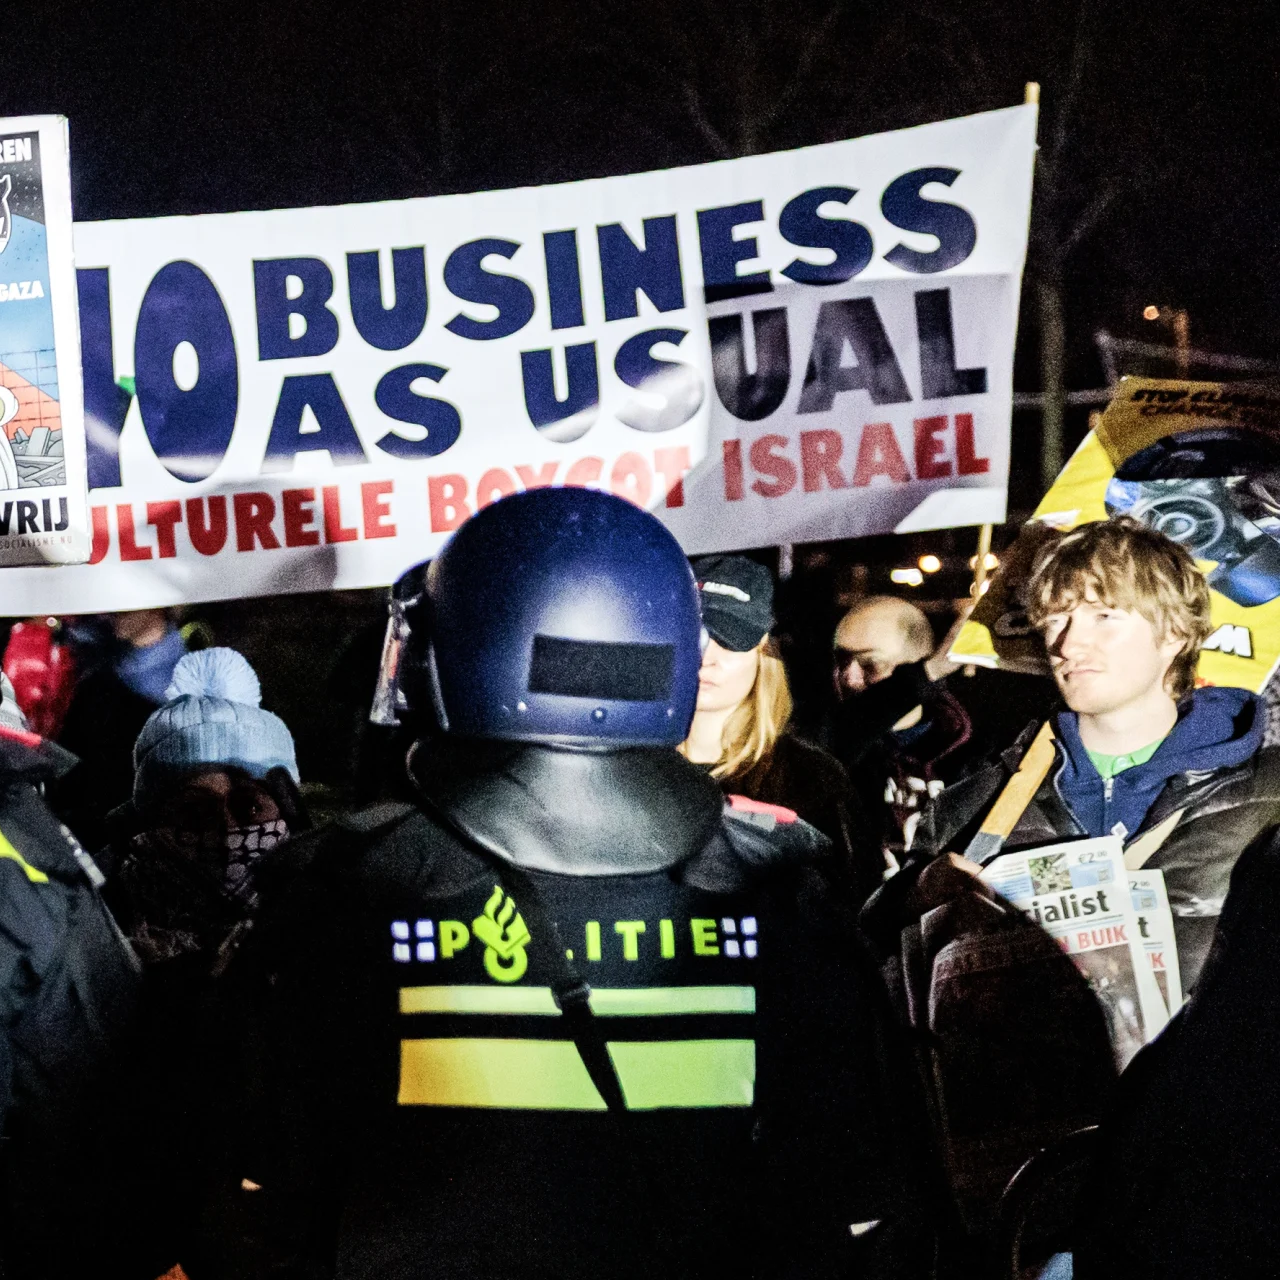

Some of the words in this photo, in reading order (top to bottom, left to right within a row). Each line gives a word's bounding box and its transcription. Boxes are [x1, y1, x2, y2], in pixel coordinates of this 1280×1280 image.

[253, 165, 977, 362] BUSINESS
[261, 362, 462, 476] AS
[519, 287, 988, 443] USUAL
[722, 413, 990, 501] ISRAEL
[1077, 925, 1129, 950] BUIK
